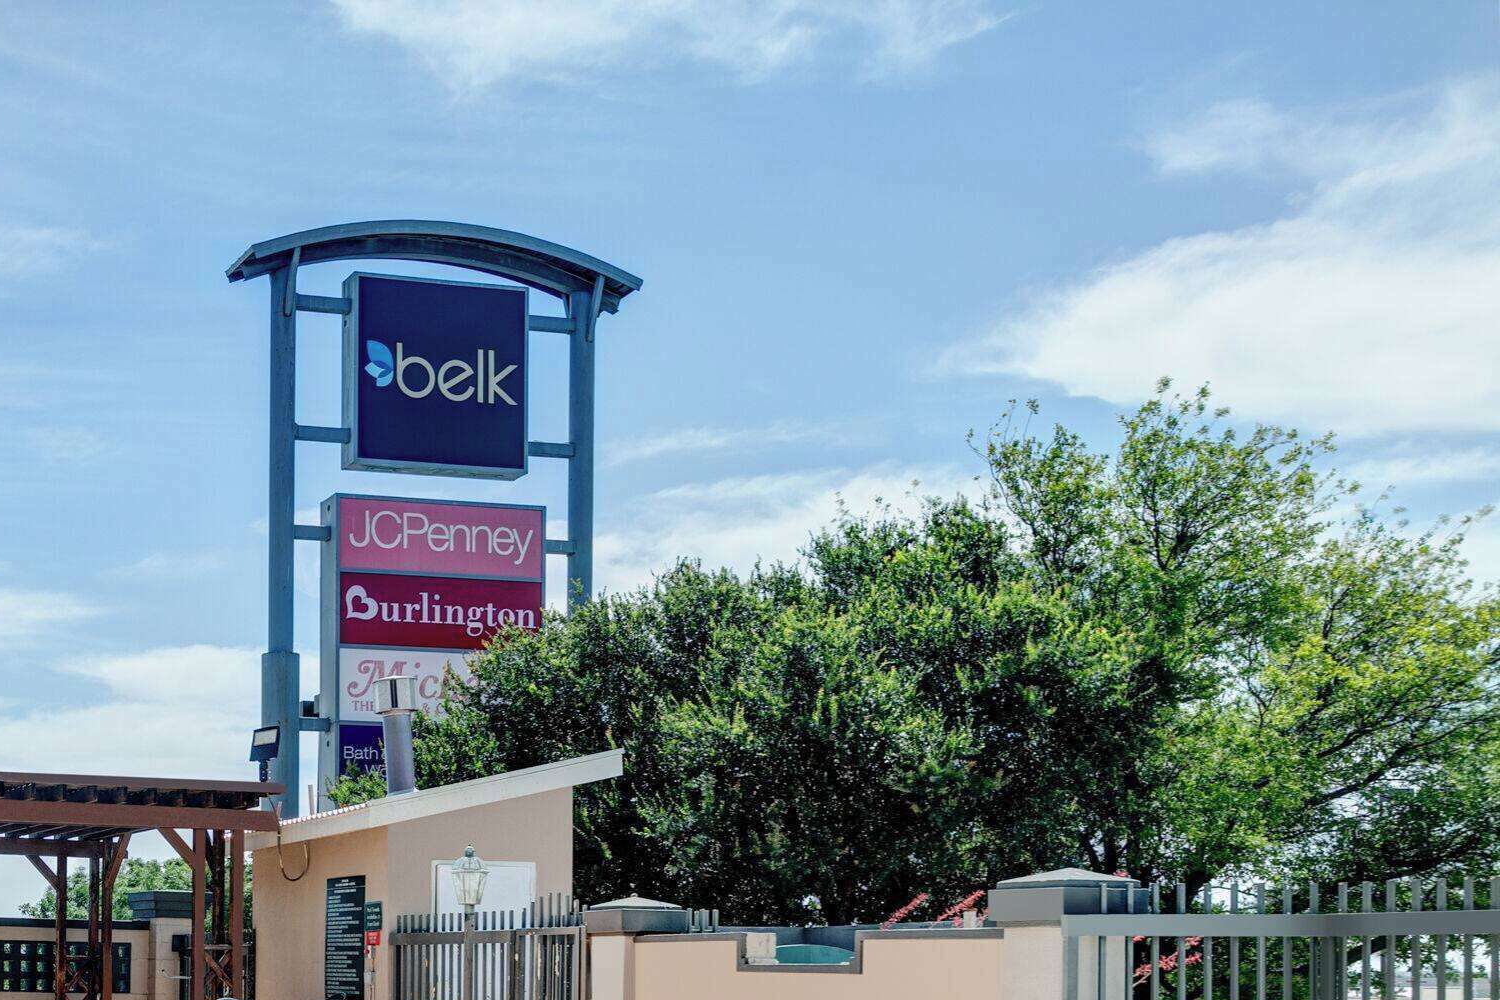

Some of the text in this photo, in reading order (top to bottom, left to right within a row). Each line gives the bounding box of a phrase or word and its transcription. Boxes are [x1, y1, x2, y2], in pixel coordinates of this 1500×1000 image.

[396, 342, 518, 406] belk
[348, 509, 533, 566] JCPenney
[345, 584, 537, 637] Burlington
[343, 745, 379, 760] Bath
